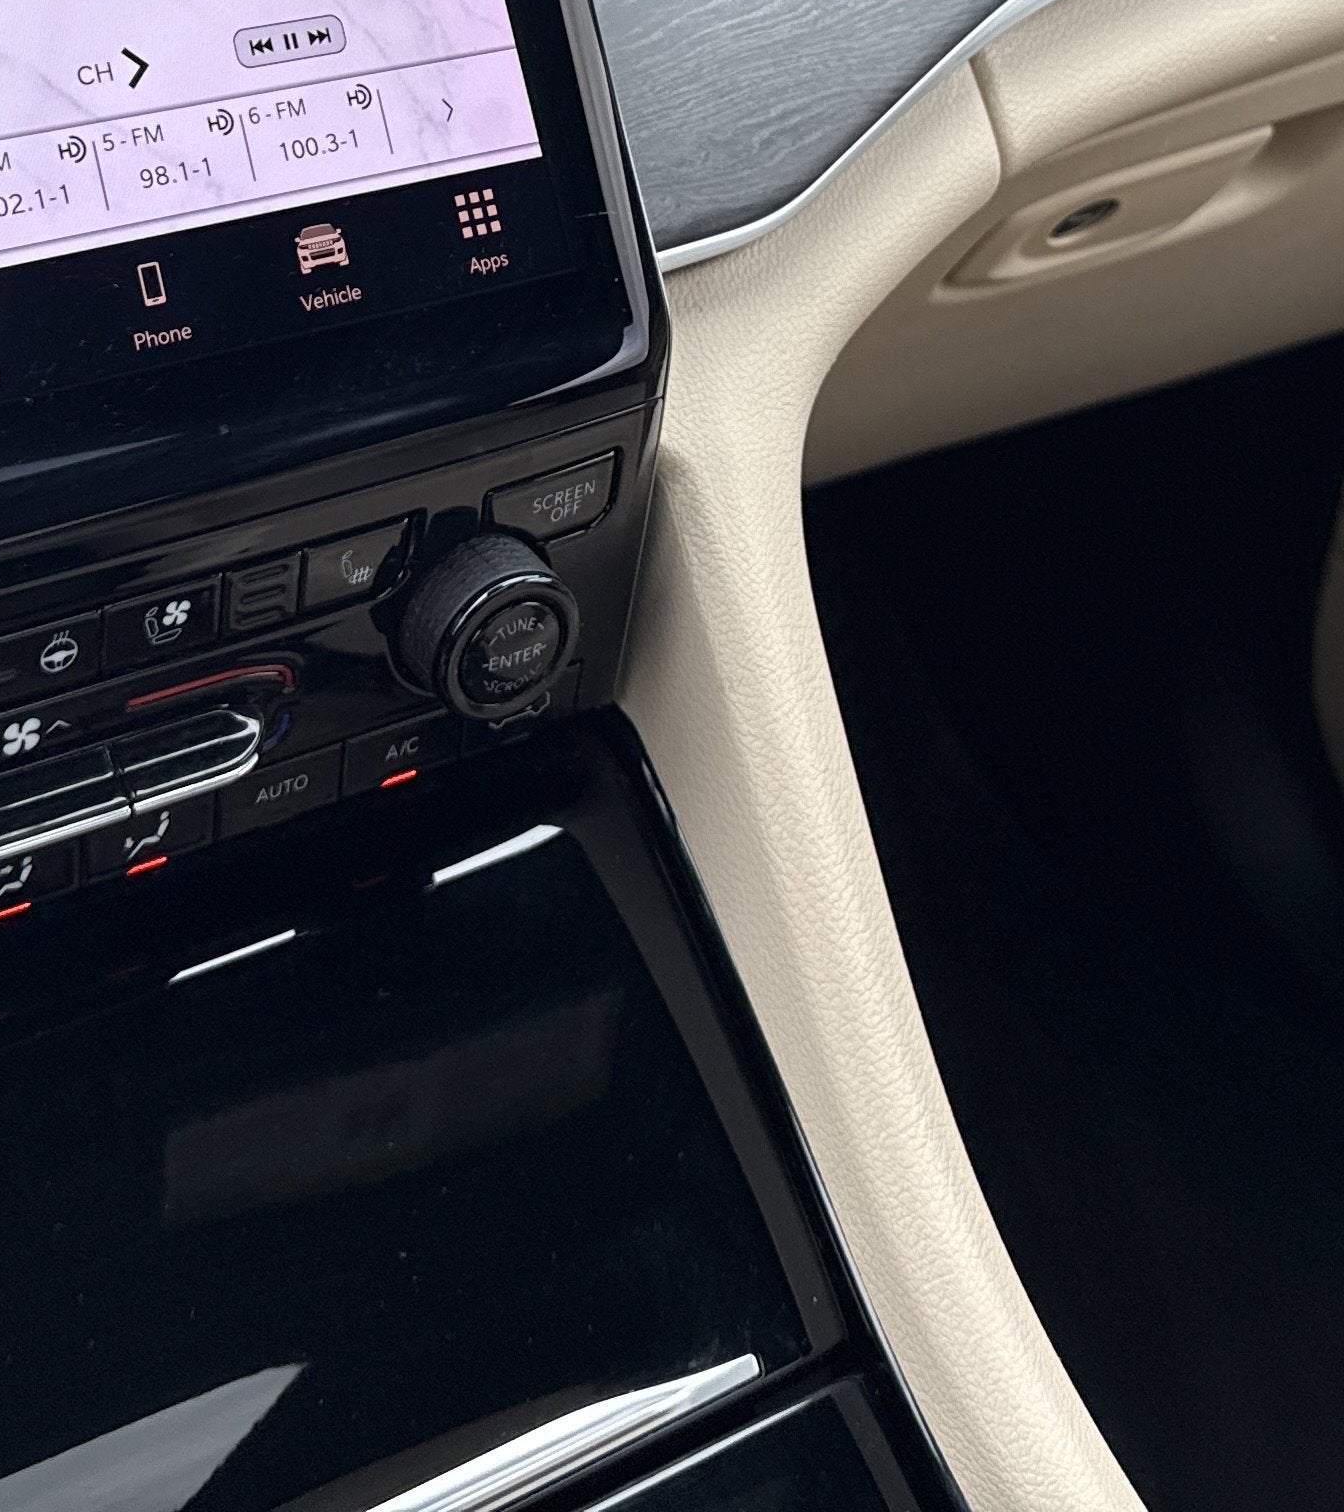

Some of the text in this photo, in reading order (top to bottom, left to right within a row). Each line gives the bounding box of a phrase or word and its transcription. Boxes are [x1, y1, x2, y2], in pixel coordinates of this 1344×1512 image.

[76, 61, 115, 88] CH
[248, 105, 261, 125] 6
[276, 98, 307, 120] FM
[101, 132, 116, 152] 5
[131, 124, 166, 146] FM
[278, 129, 360, 163] 100.3-1
[137, 157, 214, 191] 98.1-1
[470, 249, 509, 277] Apps
[299, 283, 363, 315] Vehicle
[133, 320, 192, 353] Phone
[532, 481, 597, 515] SCREEN
[550, 500, 582, 523] OFF
[497, 617, 537, 640] TUNE
[488, 642, 542, 672] ENTER
[385, 737, 419, 764] A/C
[255, 773, 309, 804] AUTO
